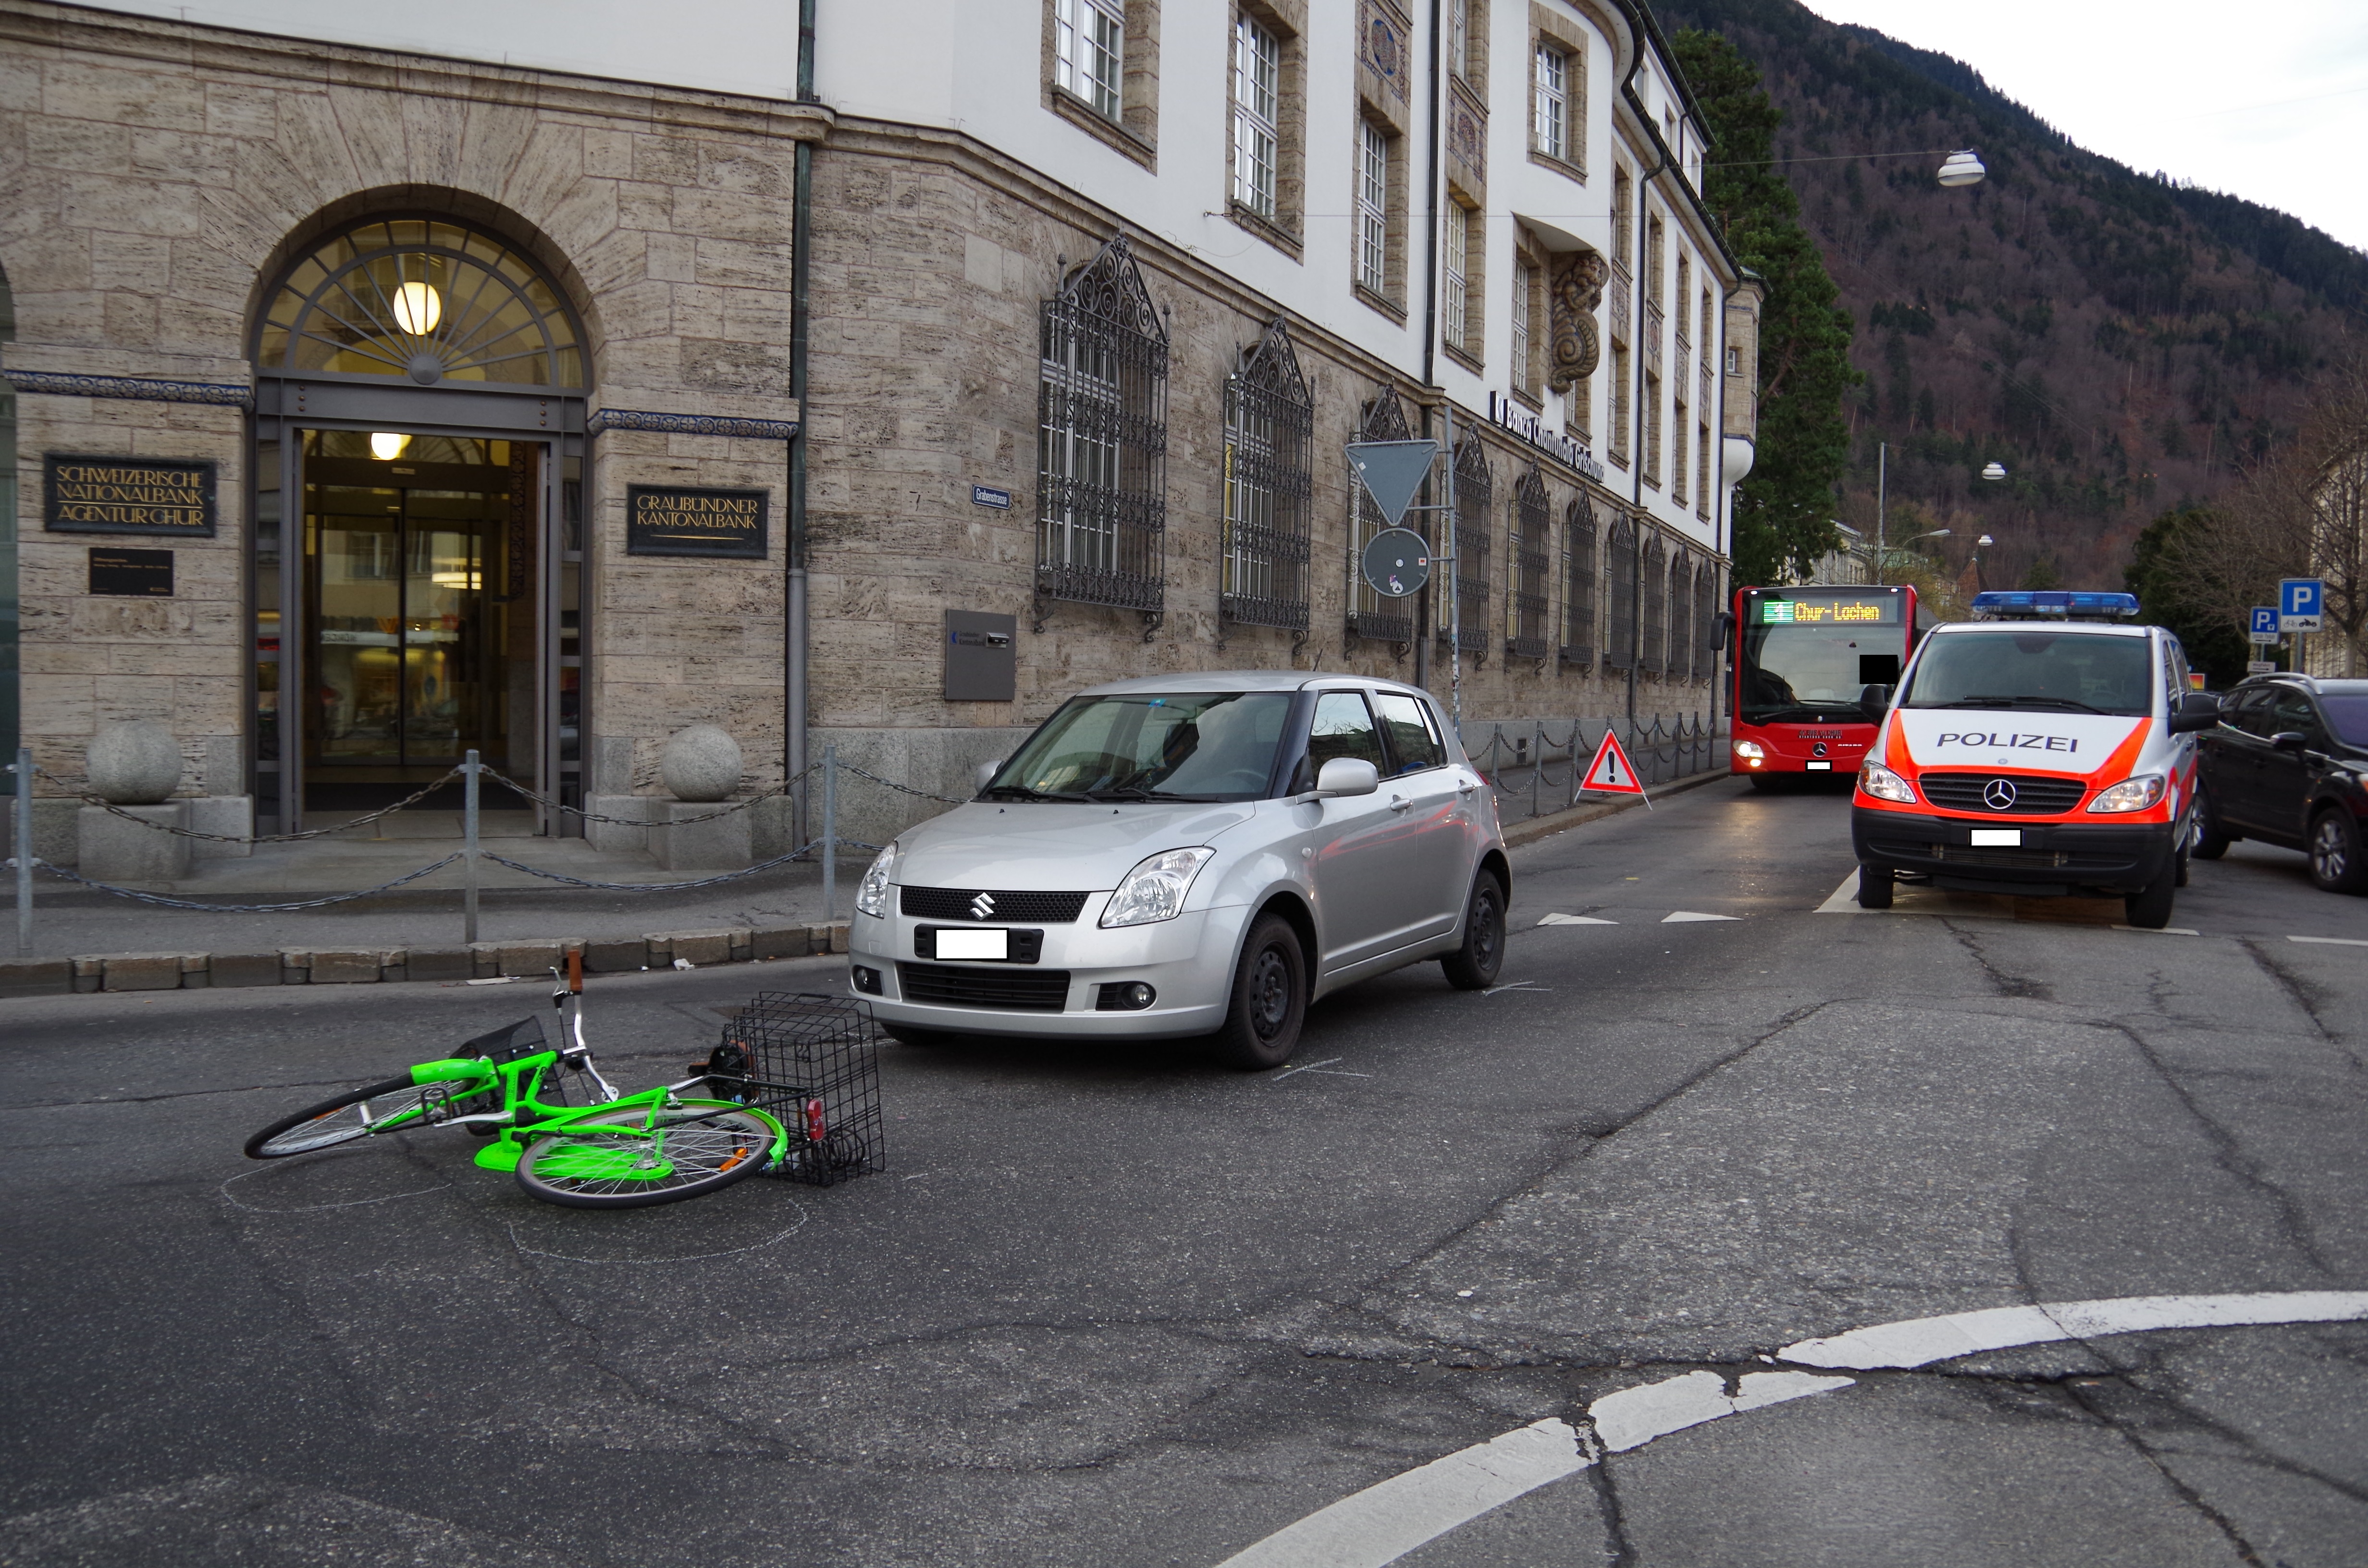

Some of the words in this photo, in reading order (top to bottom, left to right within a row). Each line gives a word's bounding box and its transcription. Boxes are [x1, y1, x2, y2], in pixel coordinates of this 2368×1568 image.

[1505, 399, 1532, 441] Banca
[1533, 417, 1574, 466] Chantunala
[1574, 443, 1605, 482] Grischuna
[56, 466, 204, 488] SCHWEIZERISCHE
[57, 482, 204, 504] NATIONALBANK
[976, 488, 1007, 505] Grabenstrasse
[637, 495, 757, 514] GRAUBÜNDNER
[57, 504, 148, 524] AGENTUR
[149, 508, 204, 526] CHUR
[637, 511, 756, 529] KANTONALBANK
[2293, 587, 2312, 612] P
[2257, 611, 2270, 629] P
[1936, 733, 2078, 752] POLIZEI
